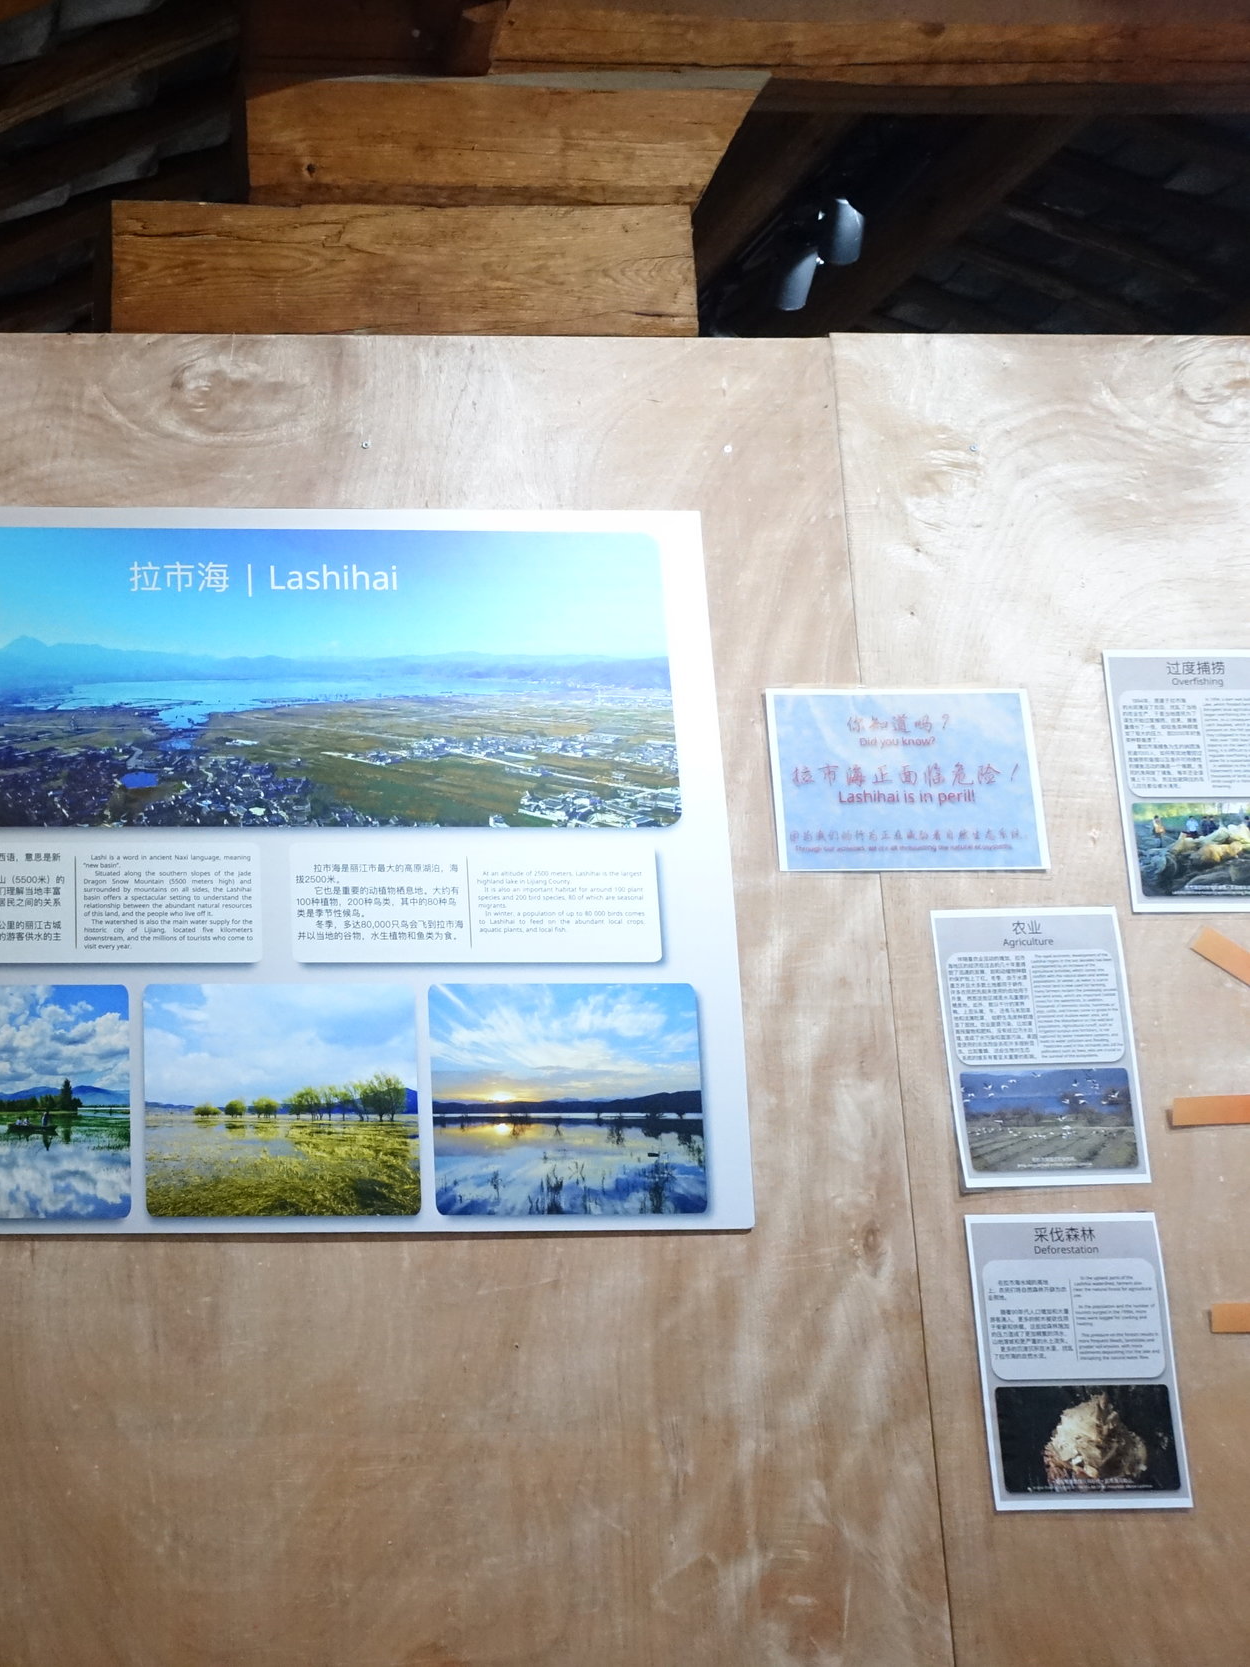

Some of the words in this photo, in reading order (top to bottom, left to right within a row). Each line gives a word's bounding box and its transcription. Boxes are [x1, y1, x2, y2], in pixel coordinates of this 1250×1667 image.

[129, 560, 230, 593] 拉市海
[270, 564, 398, 591] Lashihai
[1166, 660, 1225, 675] 过度捕捞
[1172, 677, 1224, 687] Overfishing
[847, 713, 950, 733] 你知道吗？
[860, 737, 877, 746] Did
[880, 739, 899, 749] you
[901, 737, 936, 747] know?
[792, 762, 1020, 788] 拉市海正面临危险！
[838, 791, 900, 803] Lashihai
[904, 791, 915, 803] is
[920, 791, 933, 803] in
[937, 789, 976, 806] peril!
[223, 854, 251, 862] meaning
[124, 870, 142, 878] along
[191, 870, 211, 878] slopes
[83, 878, 107, 886] Dragon
[168, 878, 187, 886] (5500
[218, 878, 235, 886] high)
[123, 886, 131, 894] by
[131, 894, 166, 902] spectacular
[169, 894, 191, 902] setting
[84, 902, 121, 910] relationship
[146, 910, 168, 918] people
[209, 918, 230, 927] supply
[1012, 920, 1042, 935] 农业
[113, 927, 124, 935] city
[1003, 938, 1054, 948] Agriculture
[1034, 1226, 1096, 1242] 采伐森林
[1034, 1245, 1099, 1255] Deforestation
